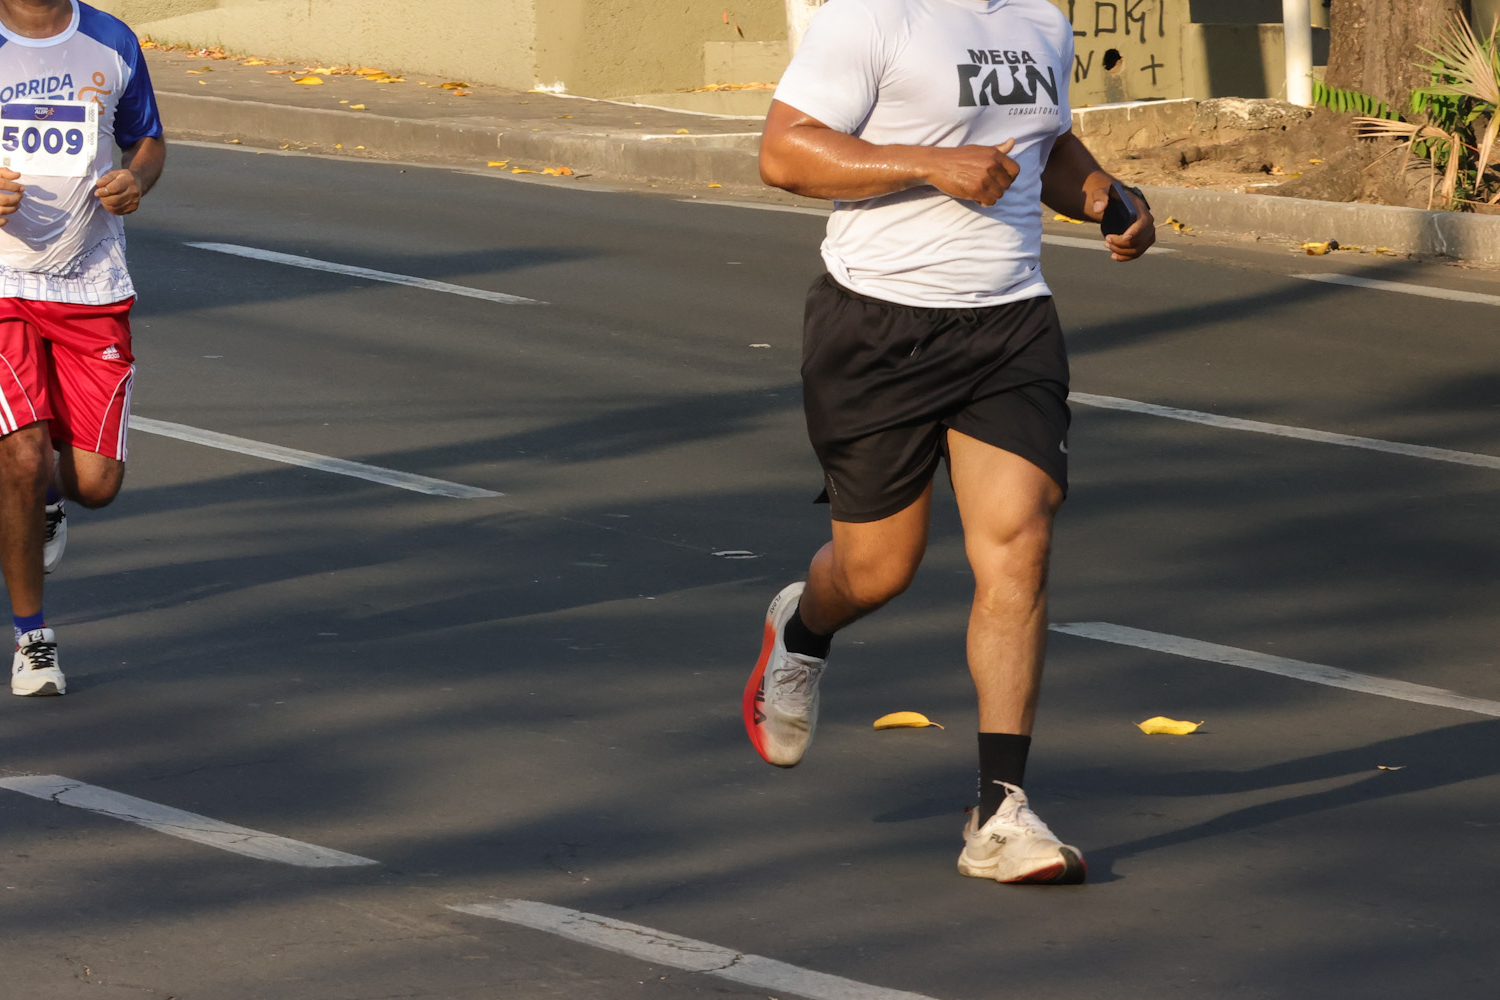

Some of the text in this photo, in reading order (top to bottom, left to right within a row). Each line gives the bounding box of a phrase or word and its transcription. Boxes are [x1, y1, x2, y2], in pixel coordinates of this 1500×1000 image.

[967, 49, 1037, 65] MEGA
[957, 64, 1059, 107] RUN
[1, 125, 84, 155] 5009
[753, 675, 767, 726] FILA
